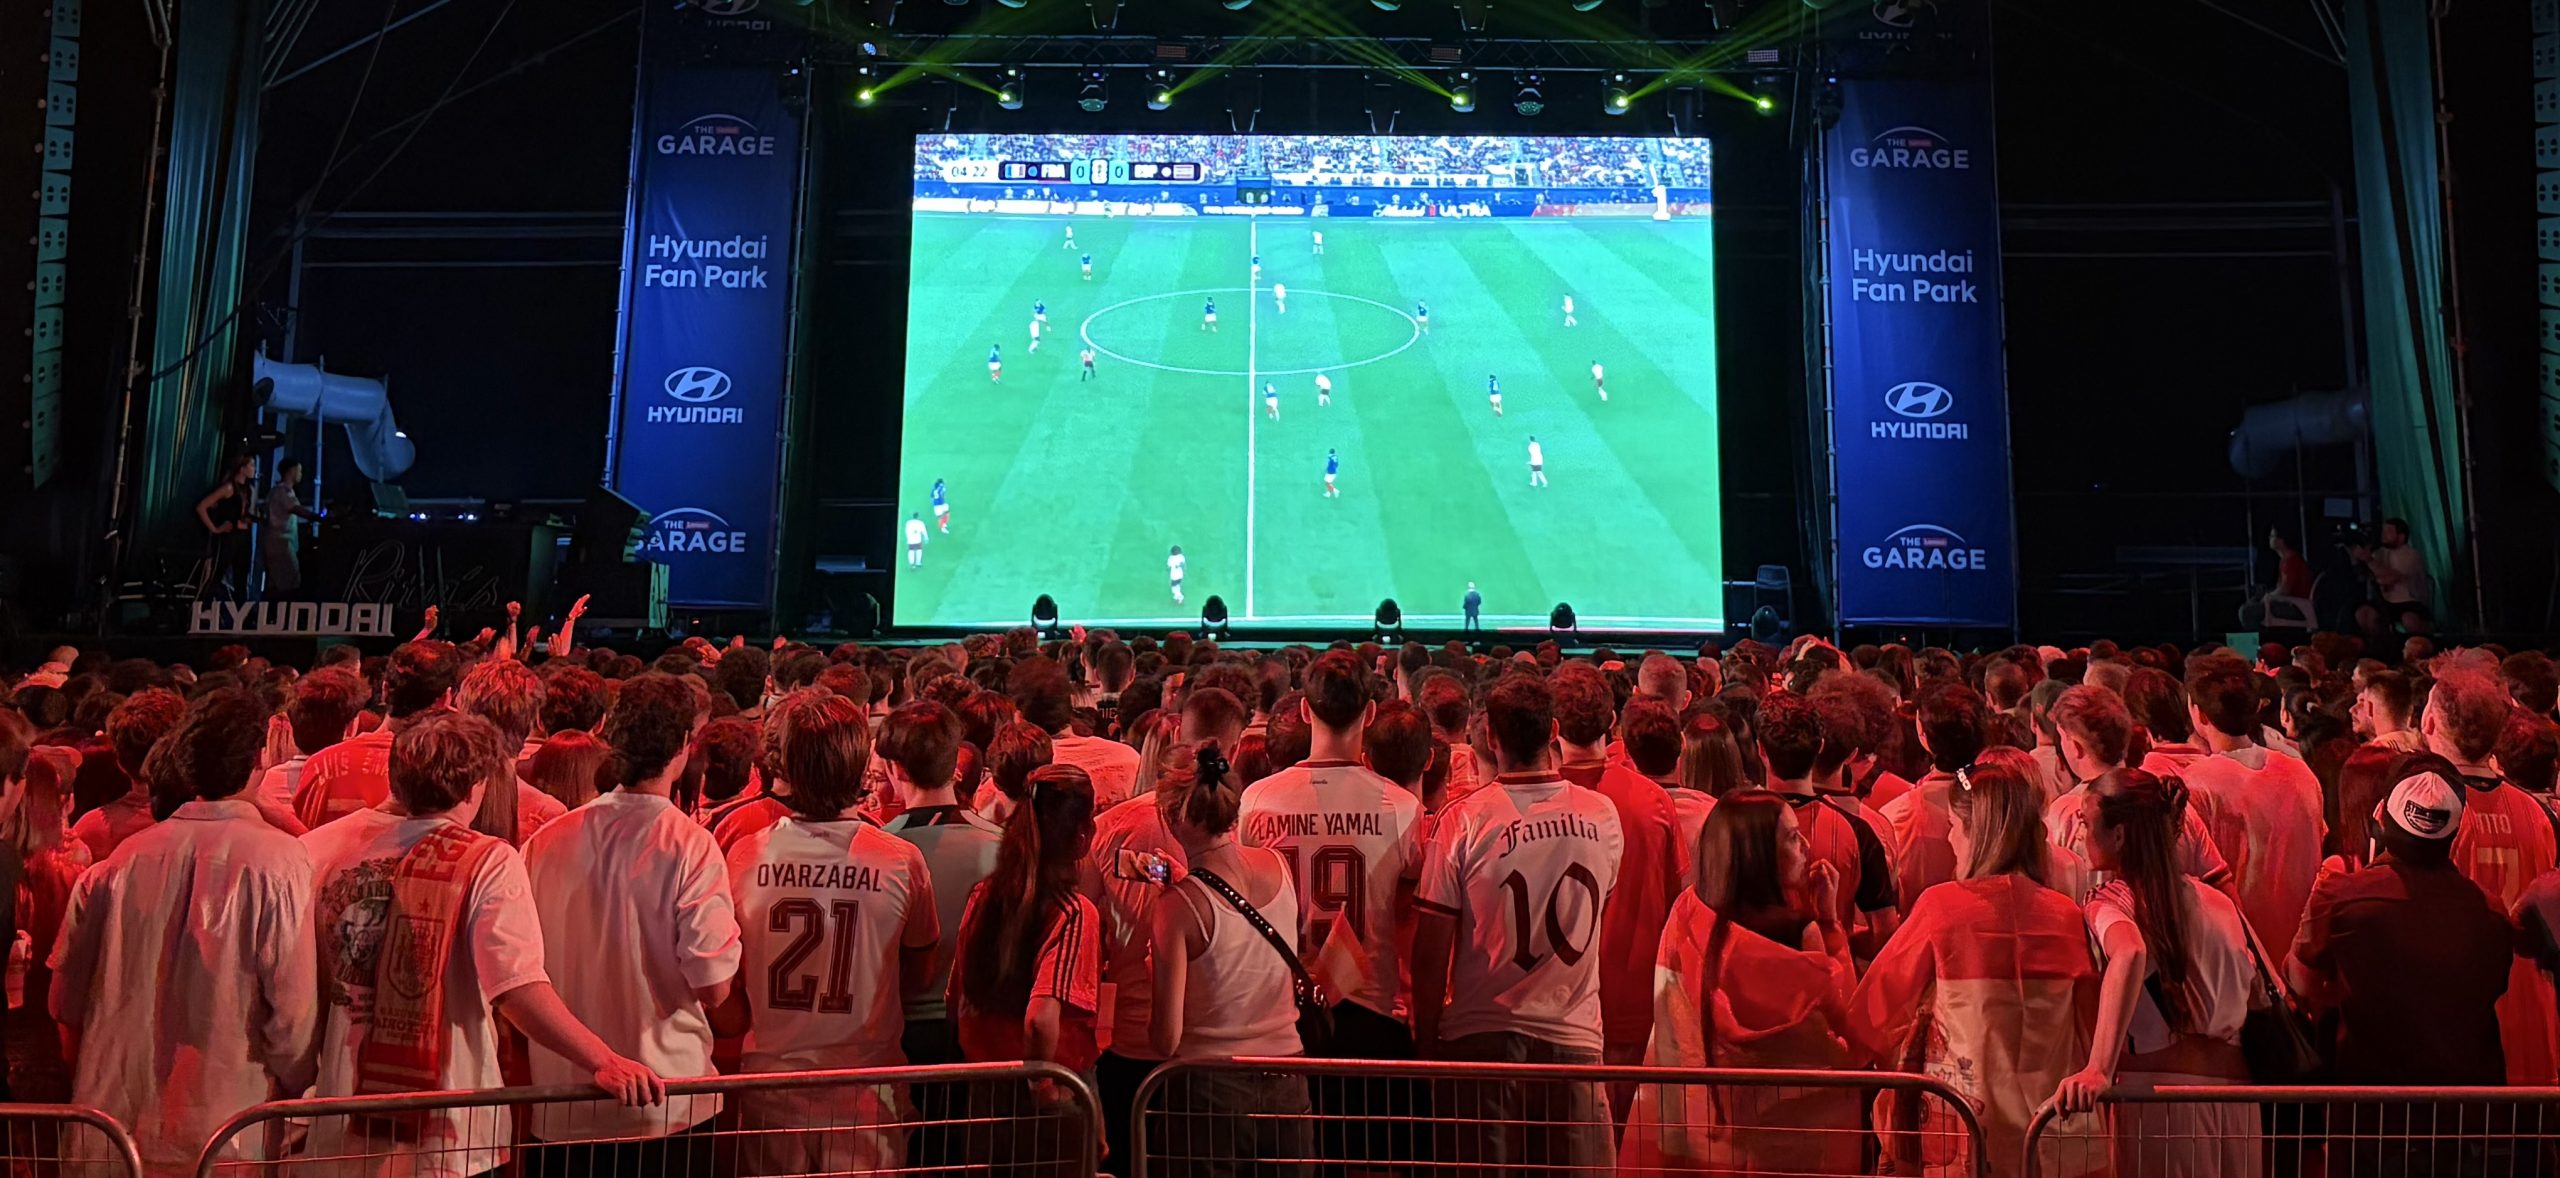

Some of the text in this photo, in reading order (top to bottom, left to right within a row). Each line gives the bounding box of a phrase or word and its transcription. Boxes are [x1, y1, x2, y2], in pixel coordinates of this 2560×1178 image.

[695, 126, 714, 134] THE
[657, 134, 775, 155] GARAGE
[1886, 138, 1906, 147] THE
[1850, 147, 1969, 169] GARAGE
[649, 234, 768, 262] Hyundai
[1853, 248, 1973, 276] Hyundai
[645, 264, 768, 288] Fan Park
[1852, 278, 1978, 303] Fan Park
[647, 406, 743, 424] HYUNDAI
[1871, 421, 1968, 439] HYUNDAI
[664, 520, 684, 530] THE
[1900, 537, 1921, 546] THE
[1862, 547, 1986, 570] GARAGE
[189, 601, 394, 635] HYUNDAI
[1258, 812, 1383, 841] LAMINE YAMAL
[1499, 813, 1600, 858] Familia
[757, 863, 882, 892] OYARZABAL
[1499, 861, 1600, 973] 10
[768, 897, 859, 1014] 21
